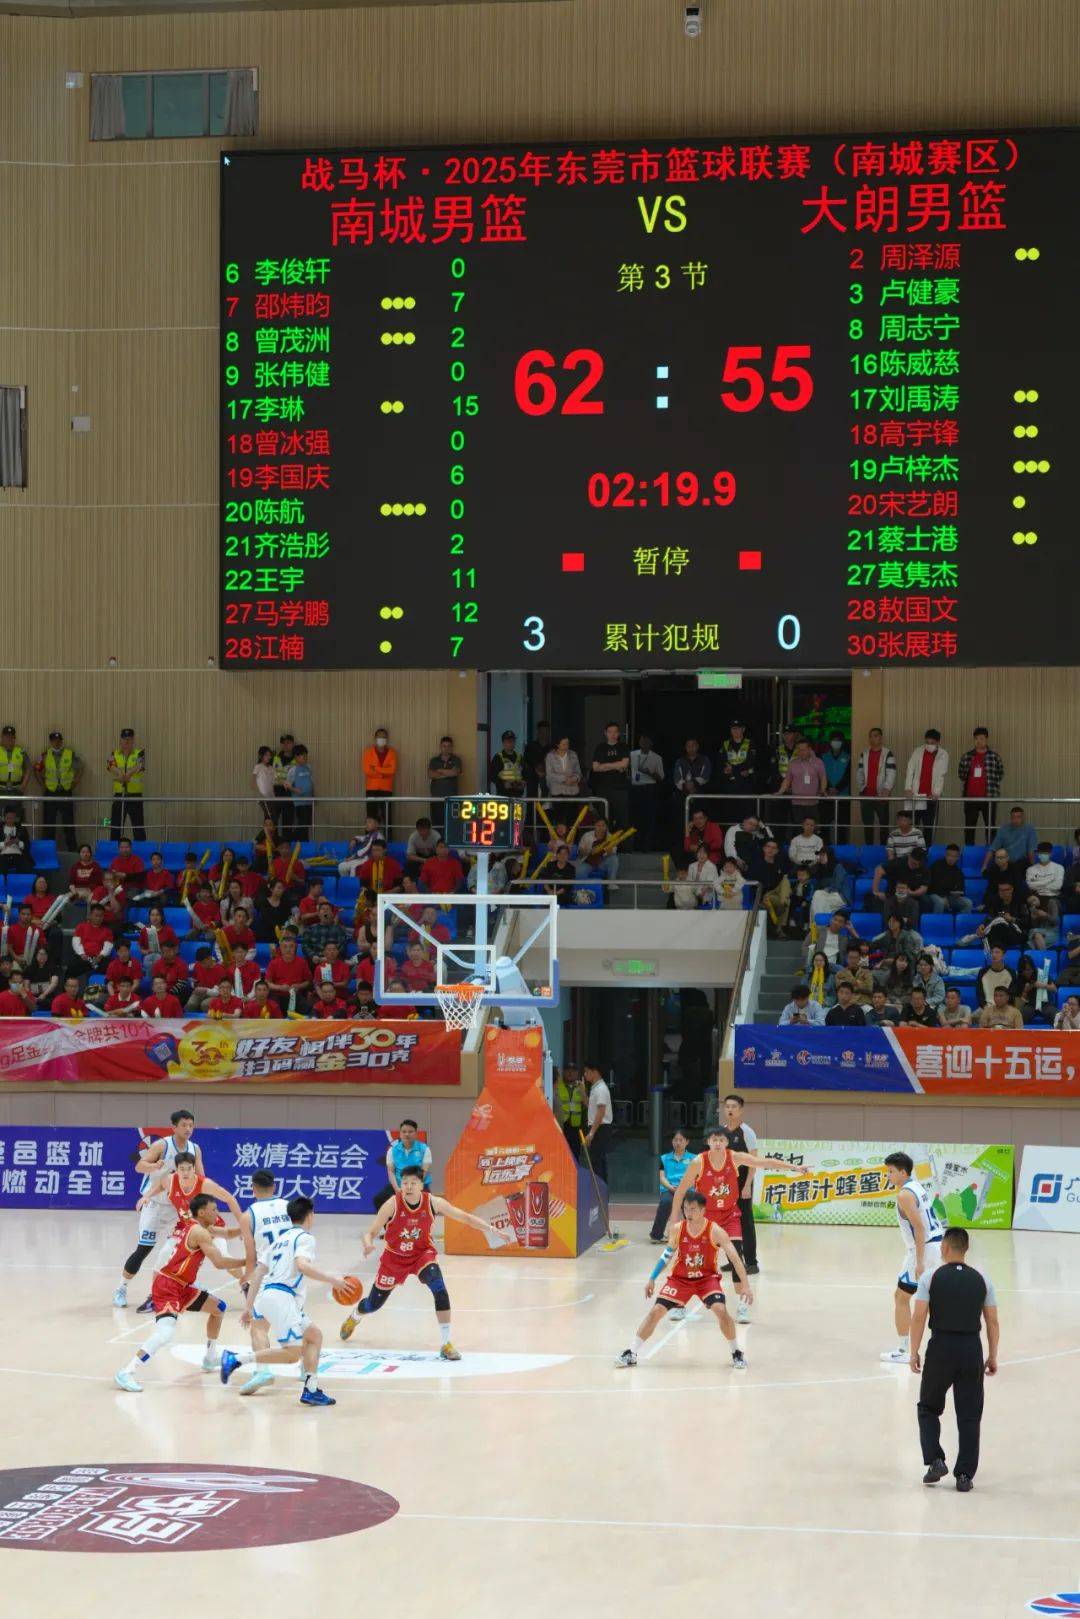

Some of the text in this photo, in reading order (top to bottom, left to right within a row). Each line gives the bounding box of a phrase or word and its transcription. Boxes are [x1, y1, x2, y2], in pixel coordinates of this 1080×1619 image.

[331, 194, 527, 246] 南城男篮
[638, 195, 687, 234] VS
[801, 180, 1007, 234] 大朗男篮
[850, 243, 960, 271] 2 周泽源
[226, 258, 465, 285] 6 李俊轩 0
[618, 262, 708, 292] 第 3 节
[227, 292, 464, 319] 7 邵炜昀 7
[850, 278, 960, 306] 3 卢健豪
[226, 326, 464, 354] 8 曾茂洲 2
[849, 313, 960, 341] 8 周志宁
[226, 360, 465, 388] 9 张伟健 0
[514, 349, 604, 417] 62
[721, 345, 814, 413] 55
[453, 395, 479, 416] 15
[451, 430, 464, 451] 0
[450, 465, 464, 485] 6
[588, 471, 737, 509] 02:19.9
[450, 499, 464, 519] 0
[450, 534, 464, 554] 2
[633, 546, 690, 576] 暂停
[452, 568, 475, 588] 11
[452, 602, 478, 622] 12
[524, 616, 546, 652] 3
[603, 622, 720, 653] 累计犯规
[778, 615, 801, 650] 0
[451, 636, 464, 657] 7
[470, 820, 496, 846] 12
[233, 1143, 369, 1169] 激情全运会
[2, 1169, 126, 1196] 燃动全运
[716, 1199, 724, 1208] 2
[141, 1230, 156, 1240] 28
[662, 1285, 678, 1297] 20
